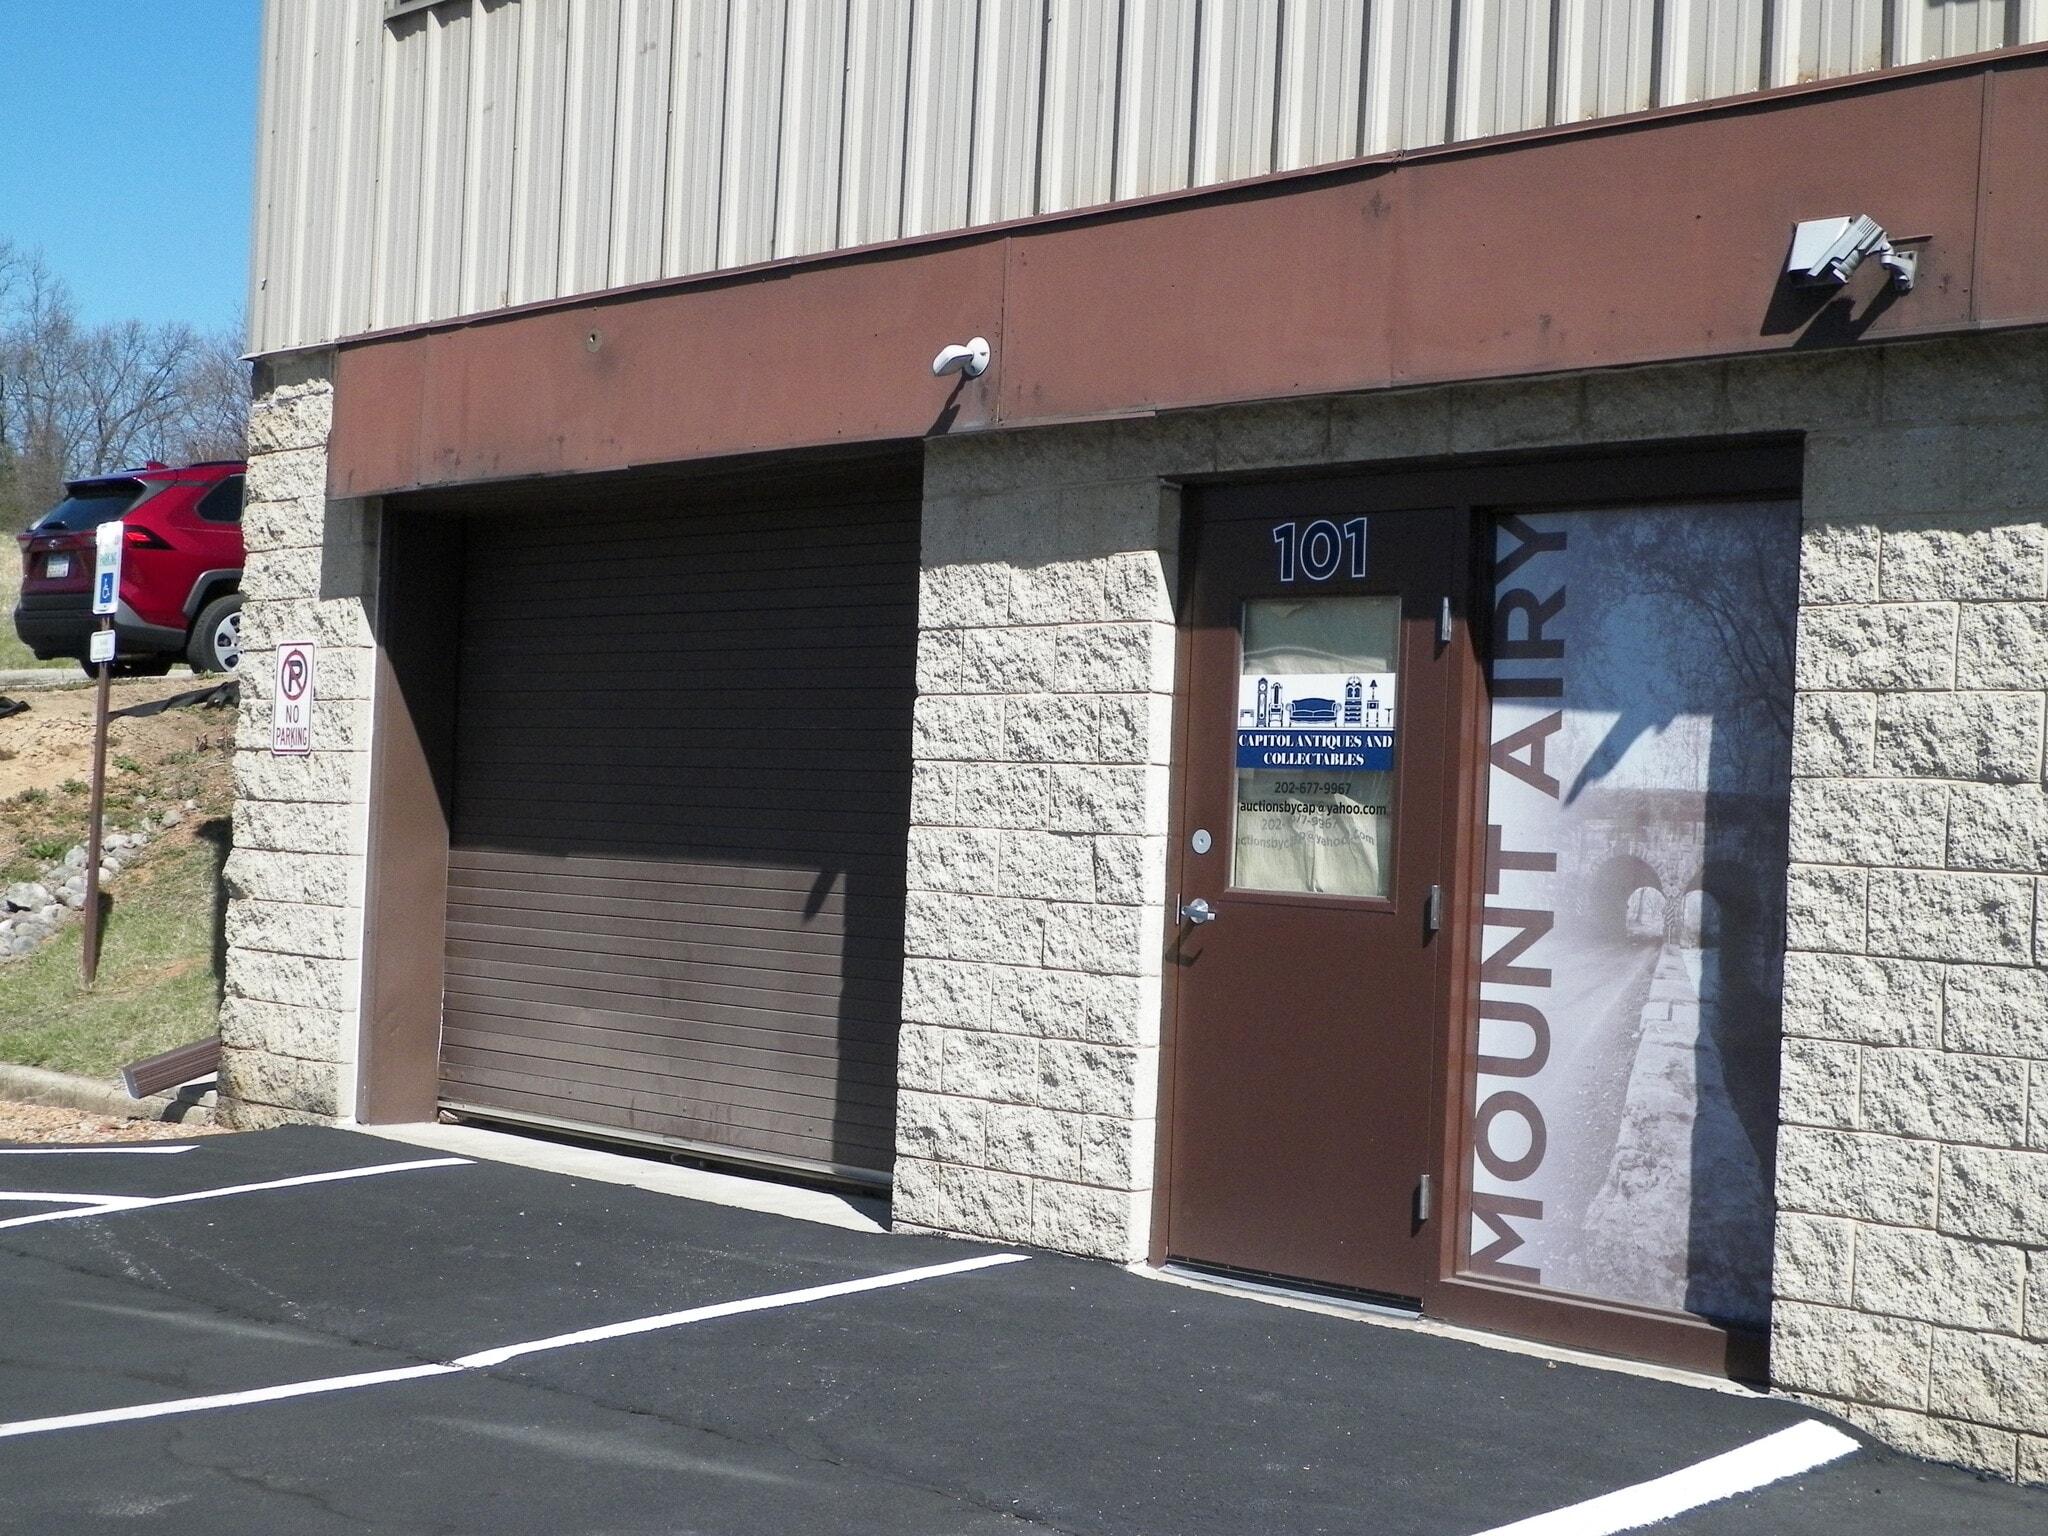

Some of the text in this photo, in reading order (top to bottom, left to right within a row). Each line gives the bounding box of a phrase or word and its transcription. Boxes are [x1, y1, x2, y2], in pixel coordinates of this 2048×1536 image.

[1272, 517, 1367, 581] 101
[285, 705, 299, 723] NO
[275, 727, 307, 746] PARKING
[1238, 734, 1393, 750] CAPITOL ANTIQUES AND
[1263, 752, 1365, 766] COLLECTABLES
[1274, 782, 1351, 795] 202-677-9967
[1240, 800, 1387, 816] auctionsbycap@yahoo.com
[1469, 514, 1567, 1285] MOUNT AIRY
